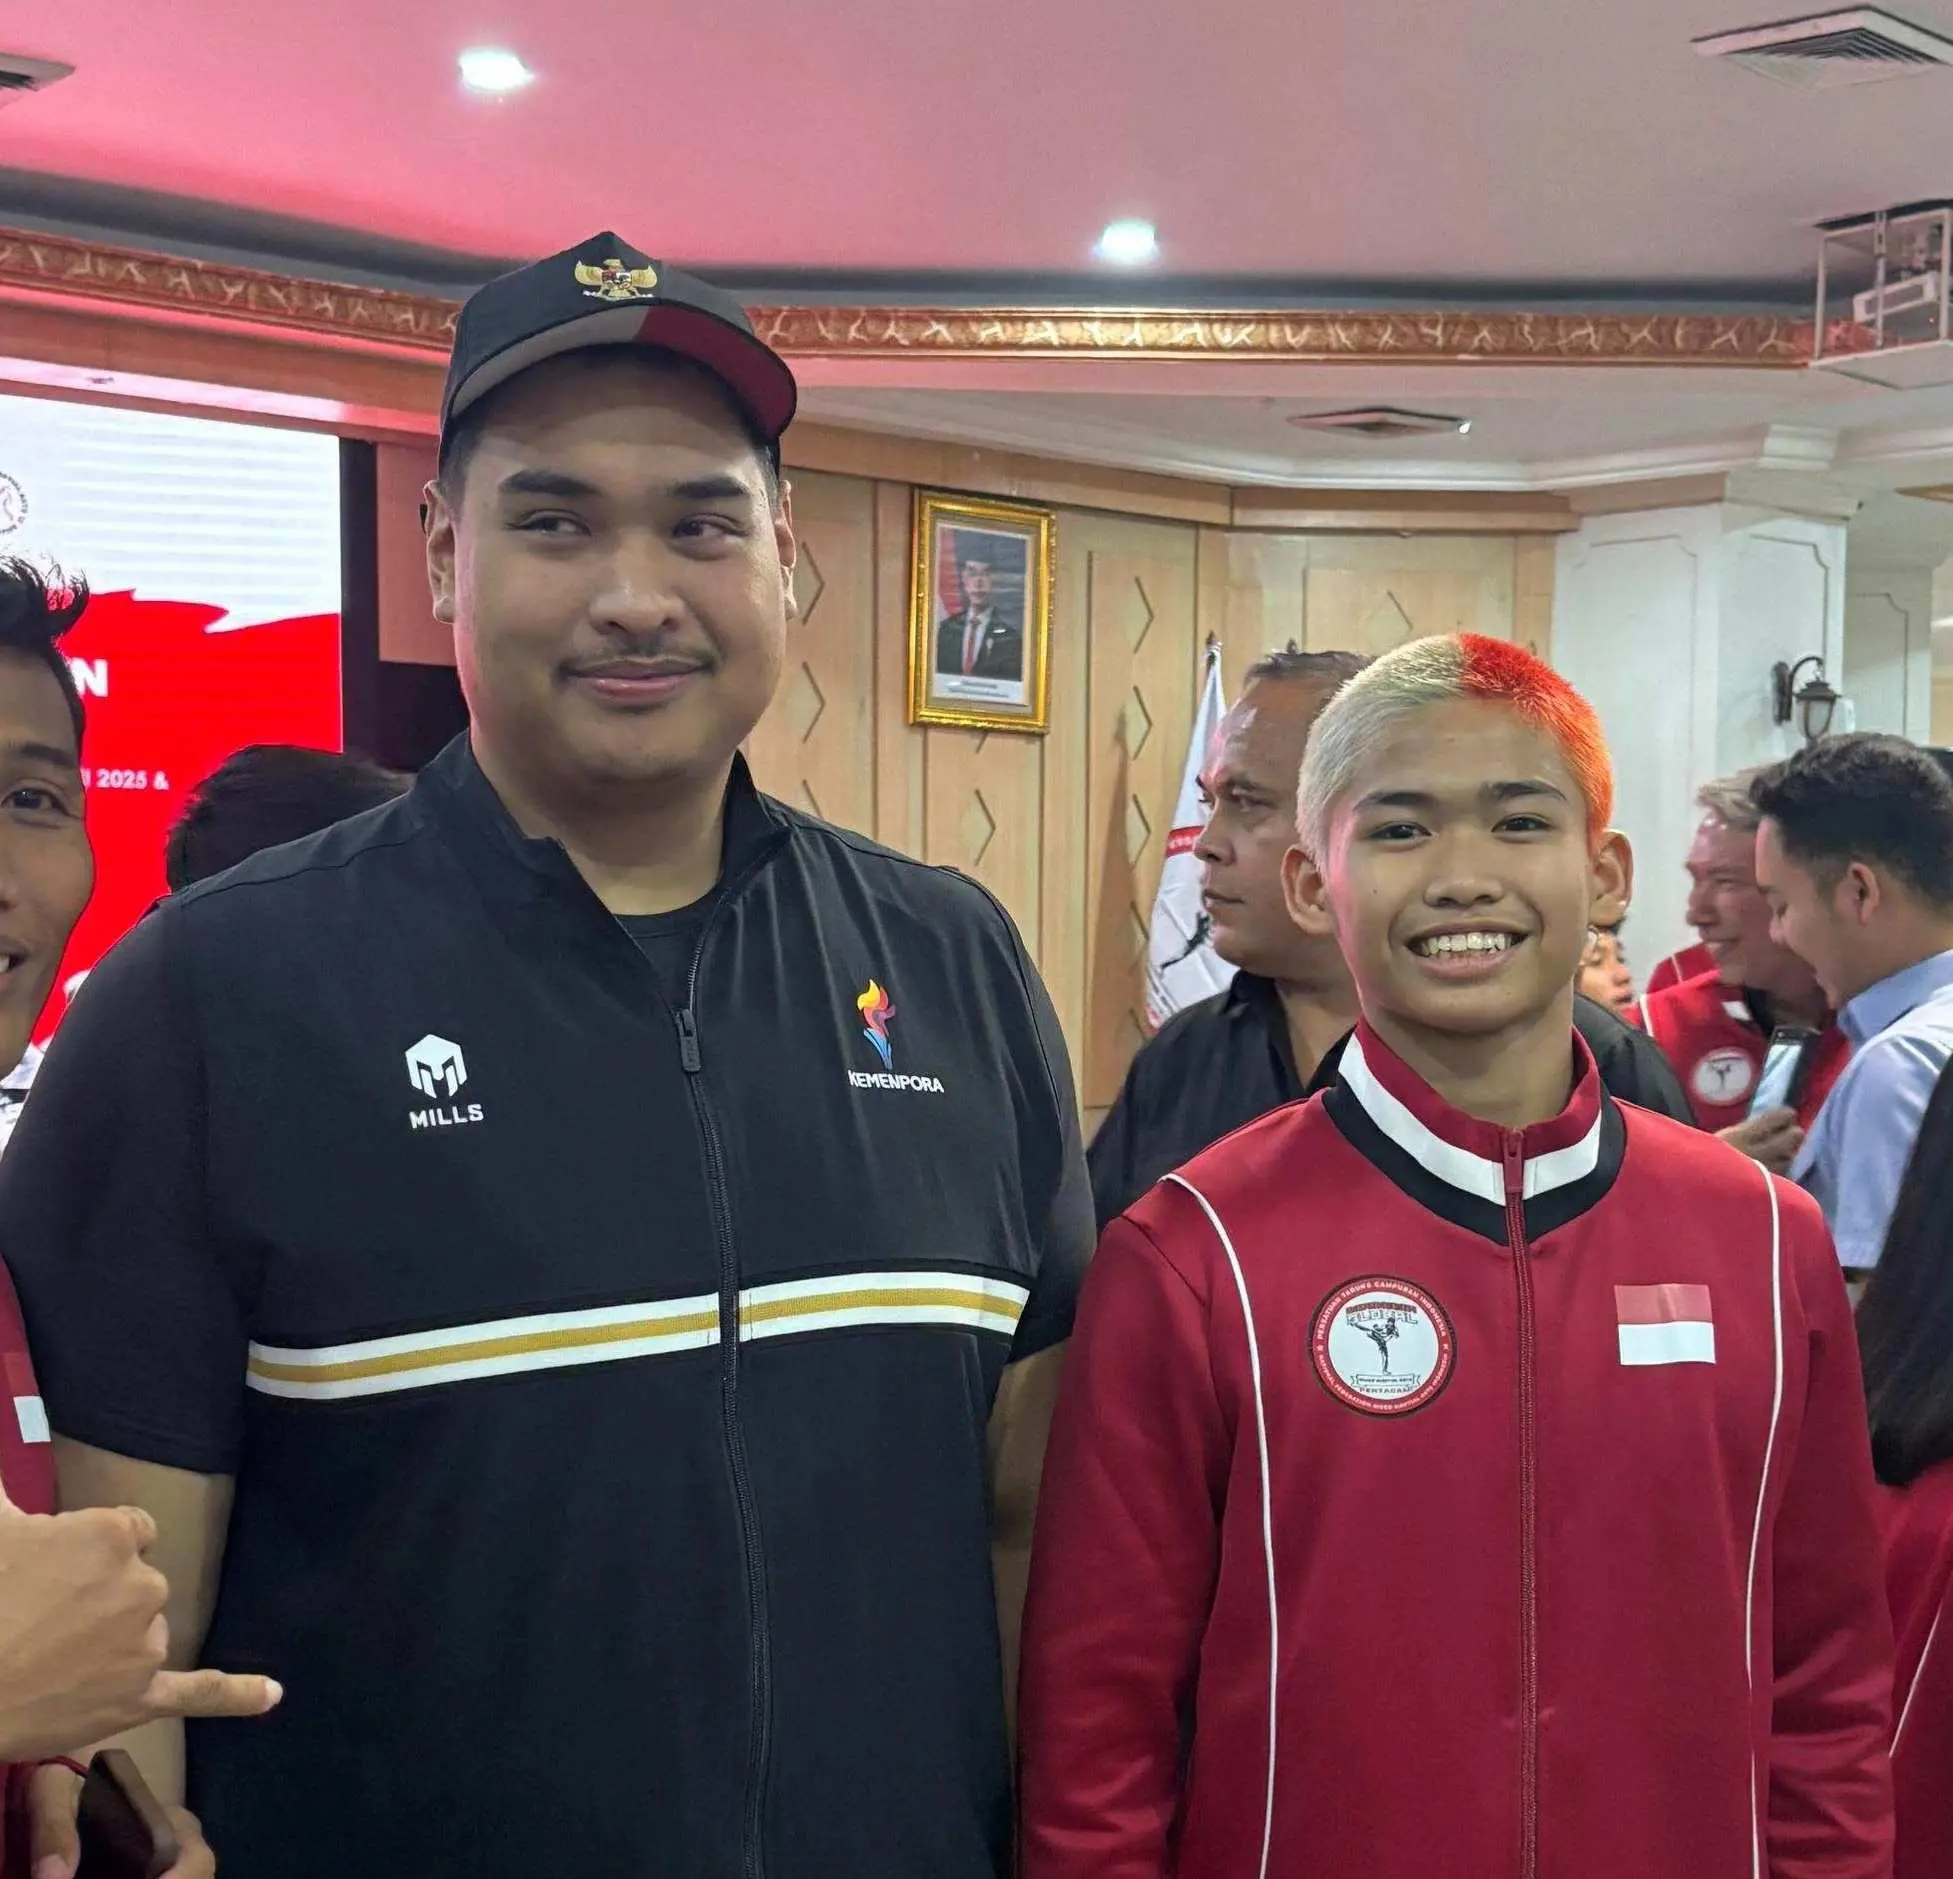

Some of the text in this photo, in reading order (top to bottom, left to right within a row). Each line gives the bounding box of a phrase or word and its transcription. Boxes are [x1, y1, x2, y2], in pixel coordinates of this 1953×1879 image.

[96, 768, 147, 789] 2025
[153, 771, 169, 790] &
[847, 1069, 945, 1093] KEMENPORA
[409, 1103, 484, 1129] MILLS
[1374, 1281, 1419, 1298] CAMPURAN
